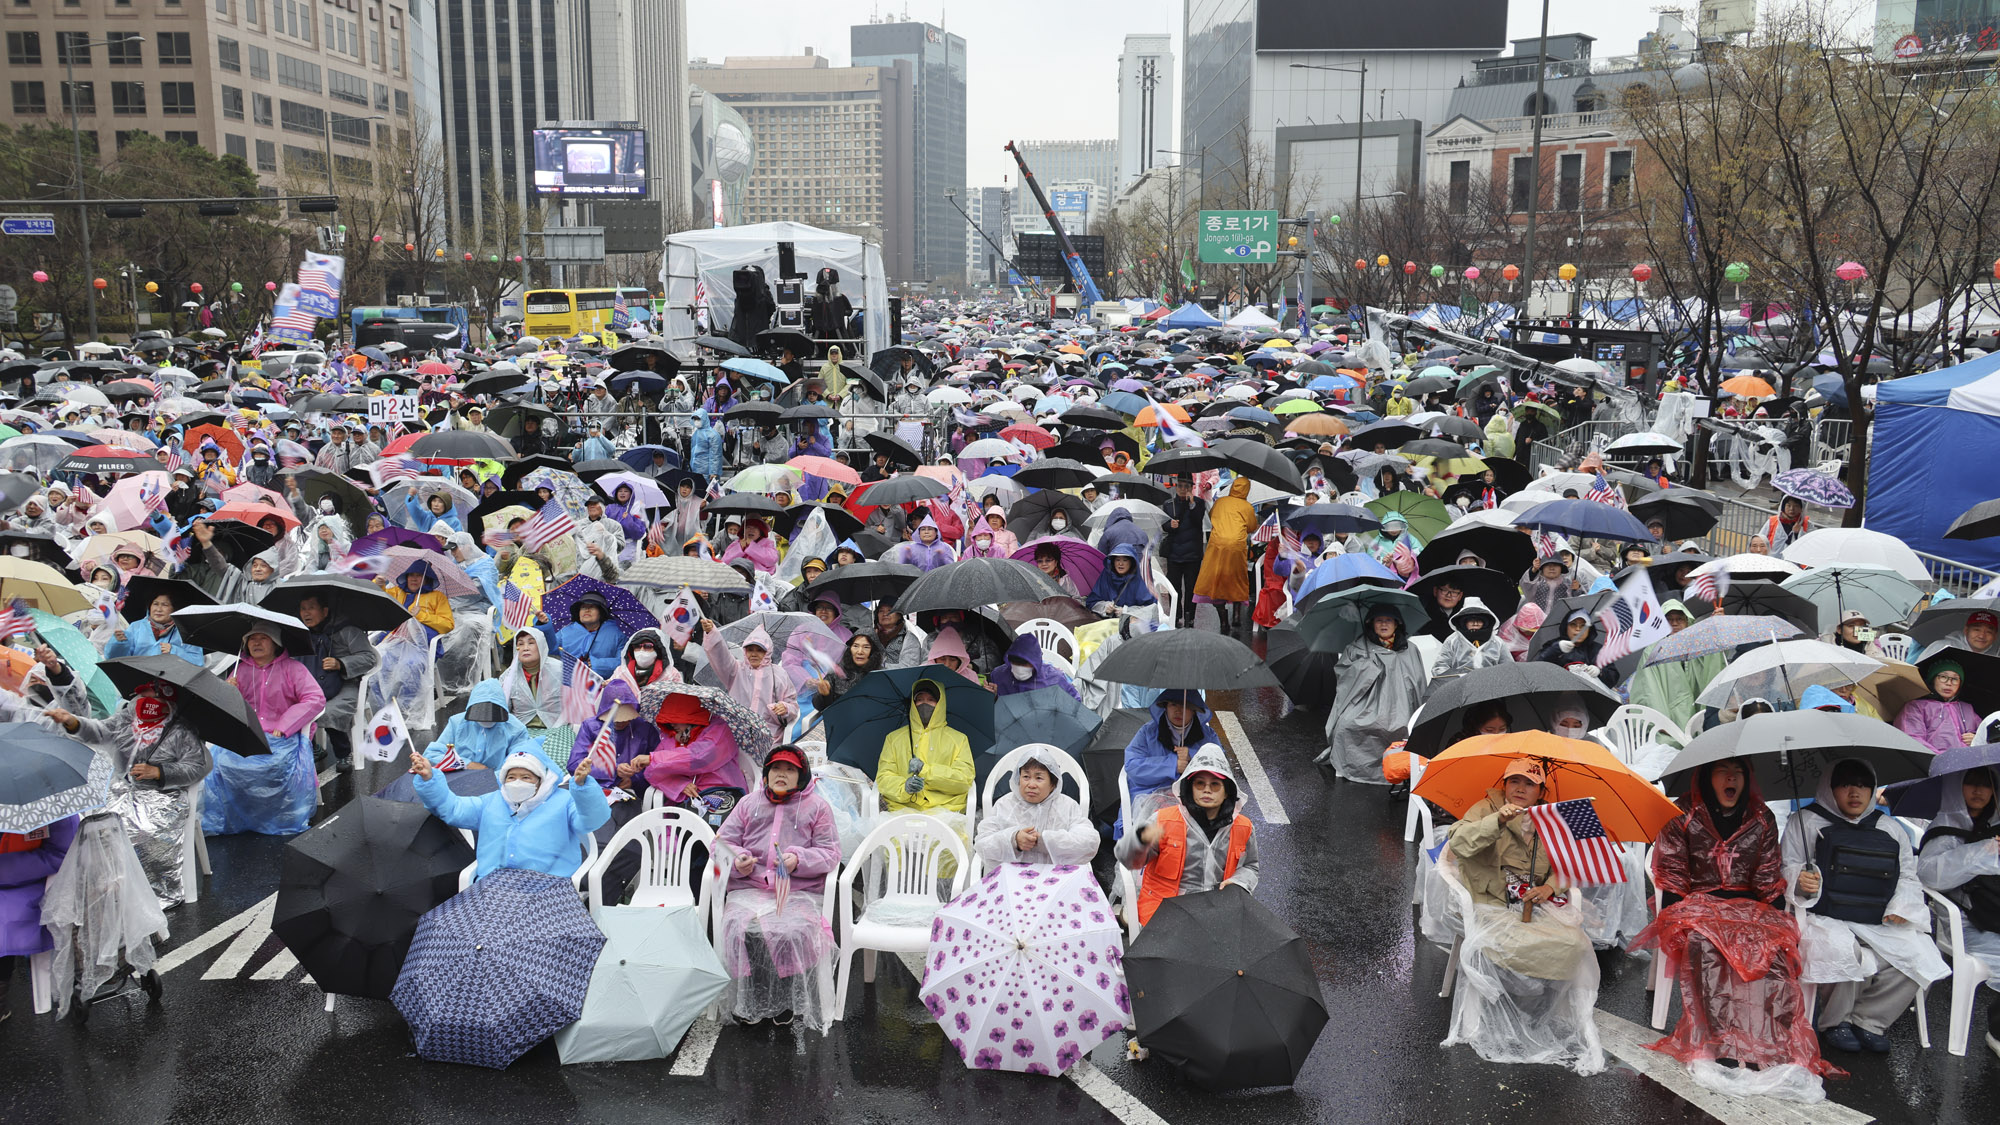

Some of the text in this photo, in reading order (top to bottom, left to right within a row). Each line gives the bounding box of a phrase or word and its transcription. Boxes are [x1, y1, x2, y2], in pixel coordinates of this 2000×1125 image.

[1205, 216, 1269, 231] 종로1가
[1204, 233, 1229, 244] Jongno
[1239, 246, 1246, 256] 6
[371, 397, 416, 420] 마 2 산
